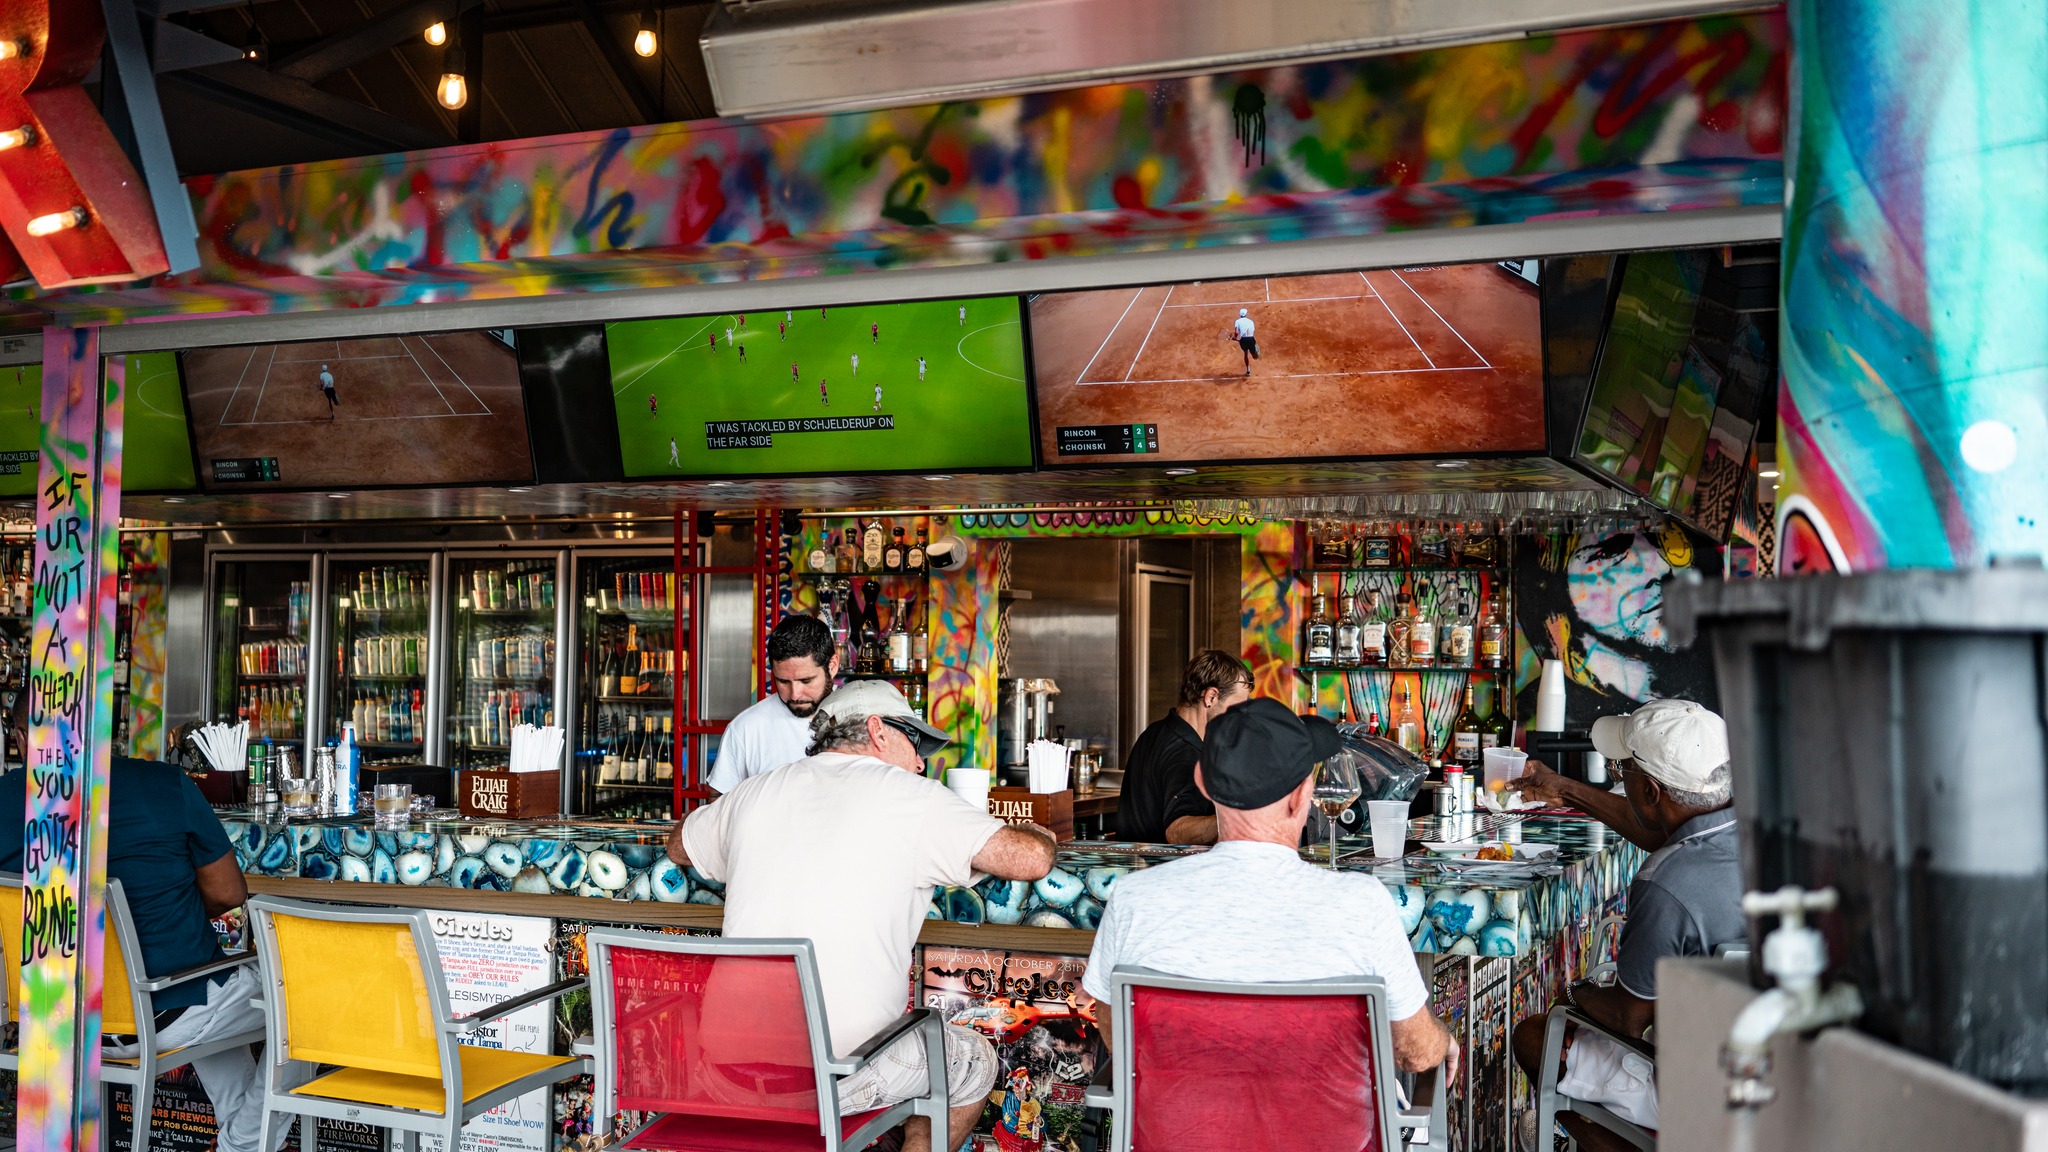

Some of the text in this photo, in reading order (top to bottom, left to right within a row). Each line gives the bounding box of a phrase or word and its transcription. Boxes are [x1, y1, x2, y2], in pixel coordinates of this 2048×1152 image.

[706, 416, 895, 434] IT WAS TACKLED BY SCHJELDERUP ON
[1064, 429, 1097, 437] RINCON
[1136, 427, 1142, 435] 2
[707, 435, 773, 448] THE FAR SIDE
[1065, 442, 1106, 451] CHOINSKI
[1148, 441, 1157, 449] 15
[29, 451, 39, 461] BY
[5, 464, 21, 473] SIDE
[44, 472, 88, 511] IF
[45, 516, 84, 555] UR
[36, 560, 85, 614] NOT
[42, 618, 68, 673] A
[37, 747, 74, 771] THEN
[32, 768, 75, 801] YOU
[471, 775, 508, 794] ELIJAH
[471, 791, 508, 812] CRAIG
[987, 797, 1034, 819] ELIJAH
[25, 812, 79, 881] GOTTA
[21, 884, 78, 967] BOUNCE
[431, 914, 513, 941] Circles
[561, 923, 594, 934] SATUR
[457, 951, 472, 959] Tampa
[478, 958, 495, 967] ZERO
[927, 951, 1085, 973] SATURDAY OCTOBER 28th
[467, 964, 479, 972] FULL
[455, 977, 473, 985] RUDELY
[468, 971, 485, 980] OBEY
[485, 973, 499, 981] OUR
[499, 974, 520, 983] RULES
[963, 966, 1077, 1000] Circles
[653, 979, 700, 994] PARTY
[927, 993, 947, 1009] 21
[514, 1024, 540, 1034] OTHER PEOPLE
[466, 1037, 475, 1046] of
[476, 1036, 503, 1049] Tampa
[175, 1099, 214, 1115] LARGE
[170, 1110, 217, 1126] FIREWOR
[482, 1114, 496, 1124] Size
[522, 1119, 545, 1130] WOW!
[172, 1132, 194, 1144] CALTA
[323, 1129, 379, 1146] FIREWORKS
[432, 1139, 443, 1148] WE
[459, 1143, 477, 1151] VERY
